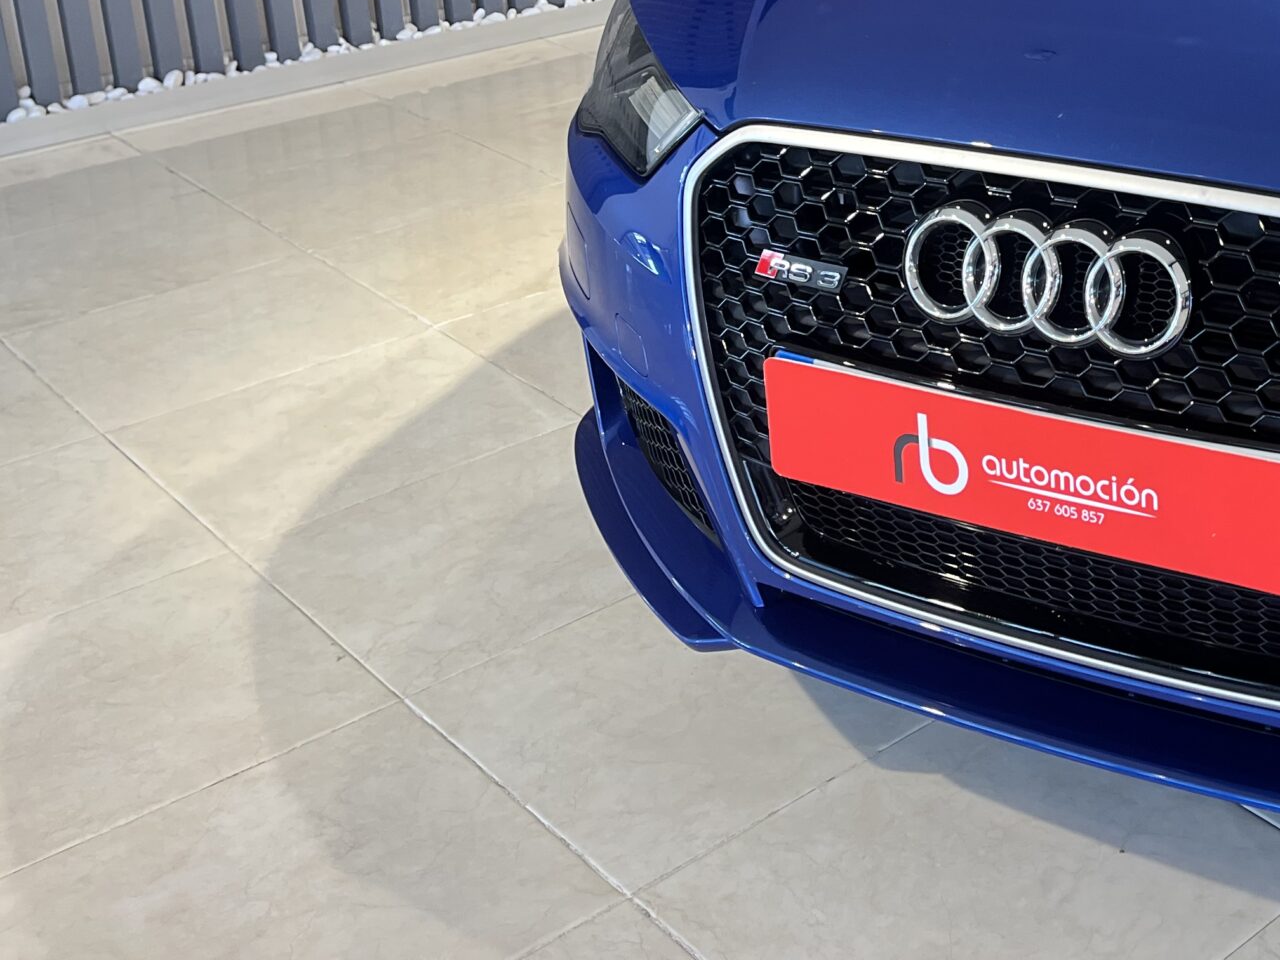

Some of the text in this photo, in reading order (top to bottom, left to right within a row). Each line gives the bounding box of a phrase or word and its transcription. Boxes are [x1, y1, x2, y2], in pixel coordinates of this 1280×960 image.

[893, 412, 1159, 511] rb automoción
[1027, 497, 1105, 525] 637 605 857
